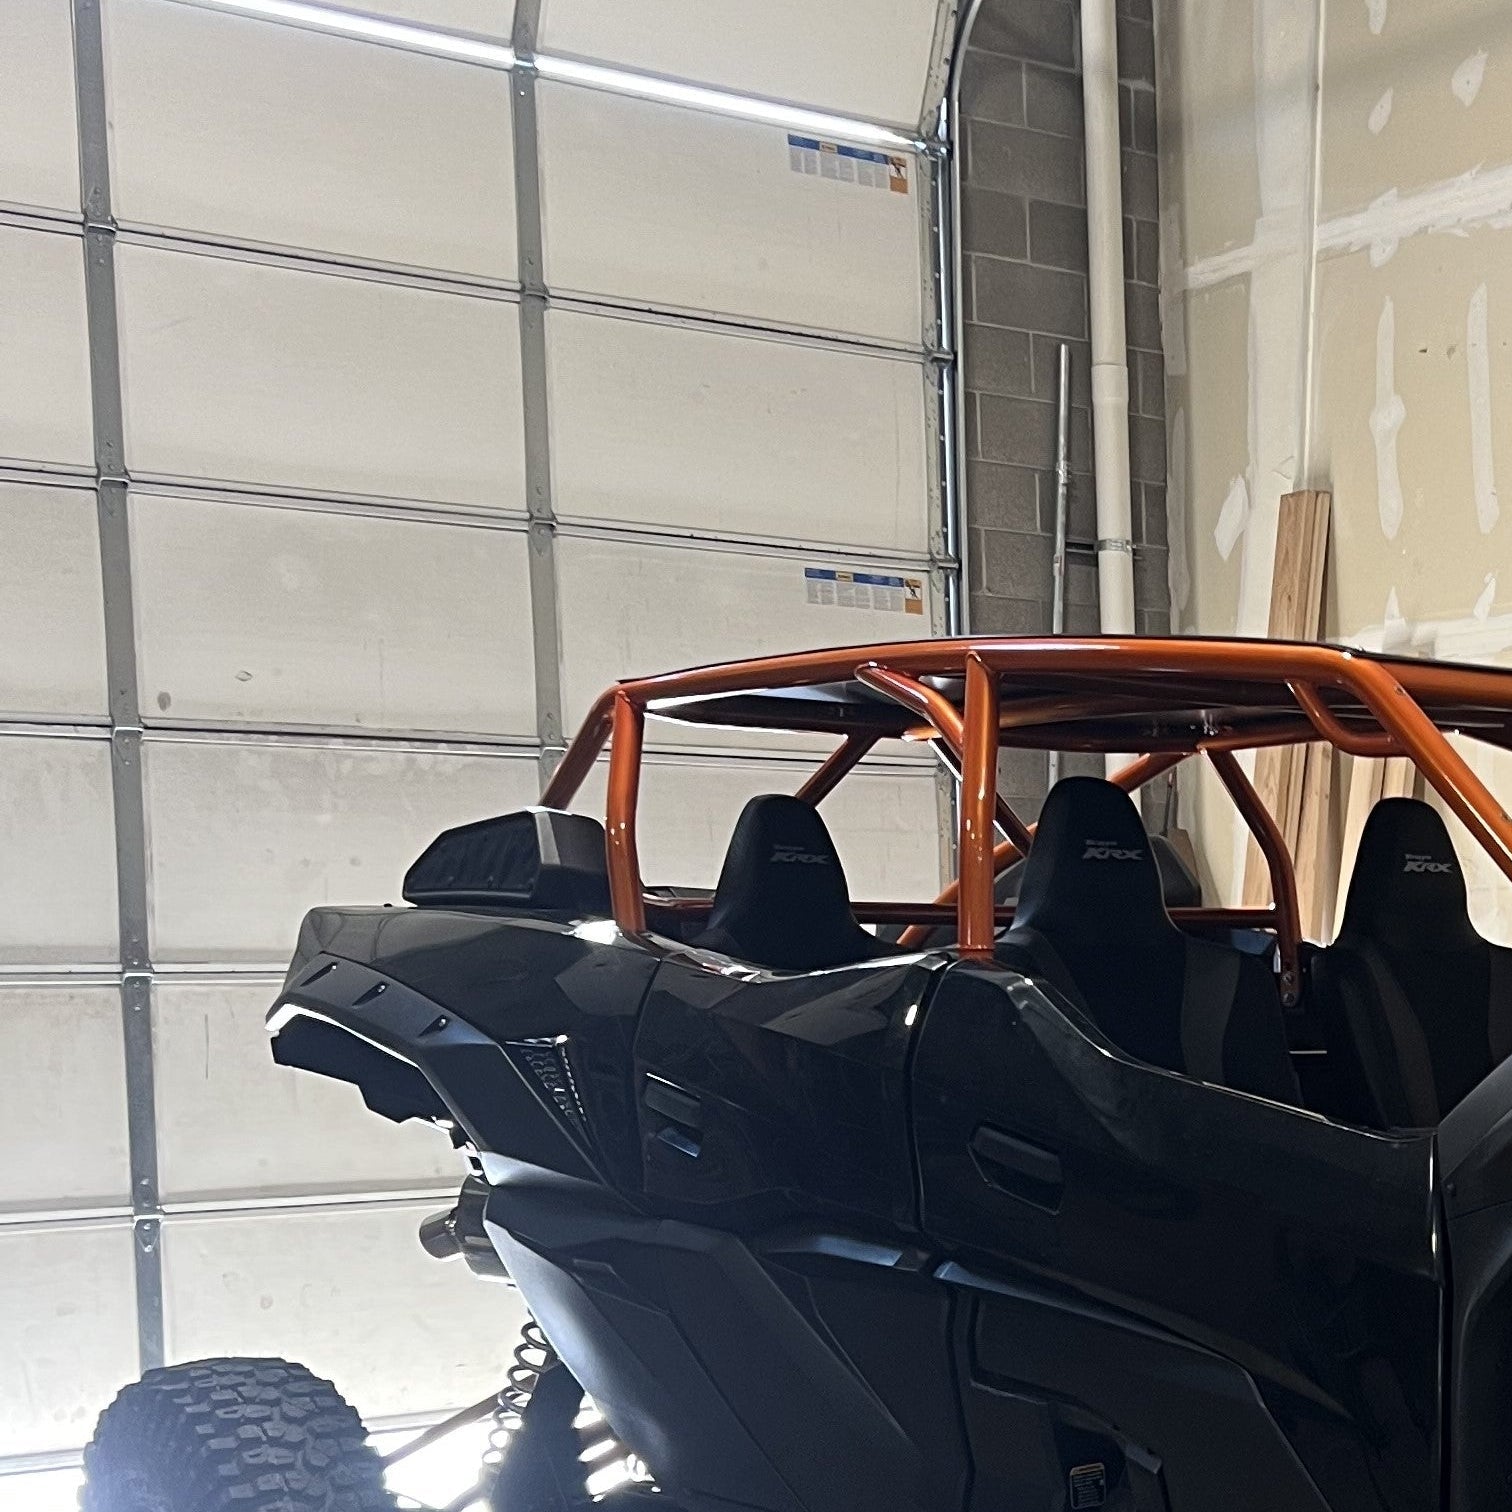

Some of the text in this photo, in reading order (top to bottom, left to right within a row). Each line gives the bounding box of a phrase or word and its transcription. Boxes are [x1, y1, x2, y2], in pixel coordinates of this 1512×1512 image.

[771, 852, 829, 864] KRX
[1082, 847, 1143, 860] KRX
[1404, 861, 1454, 872] KRX
